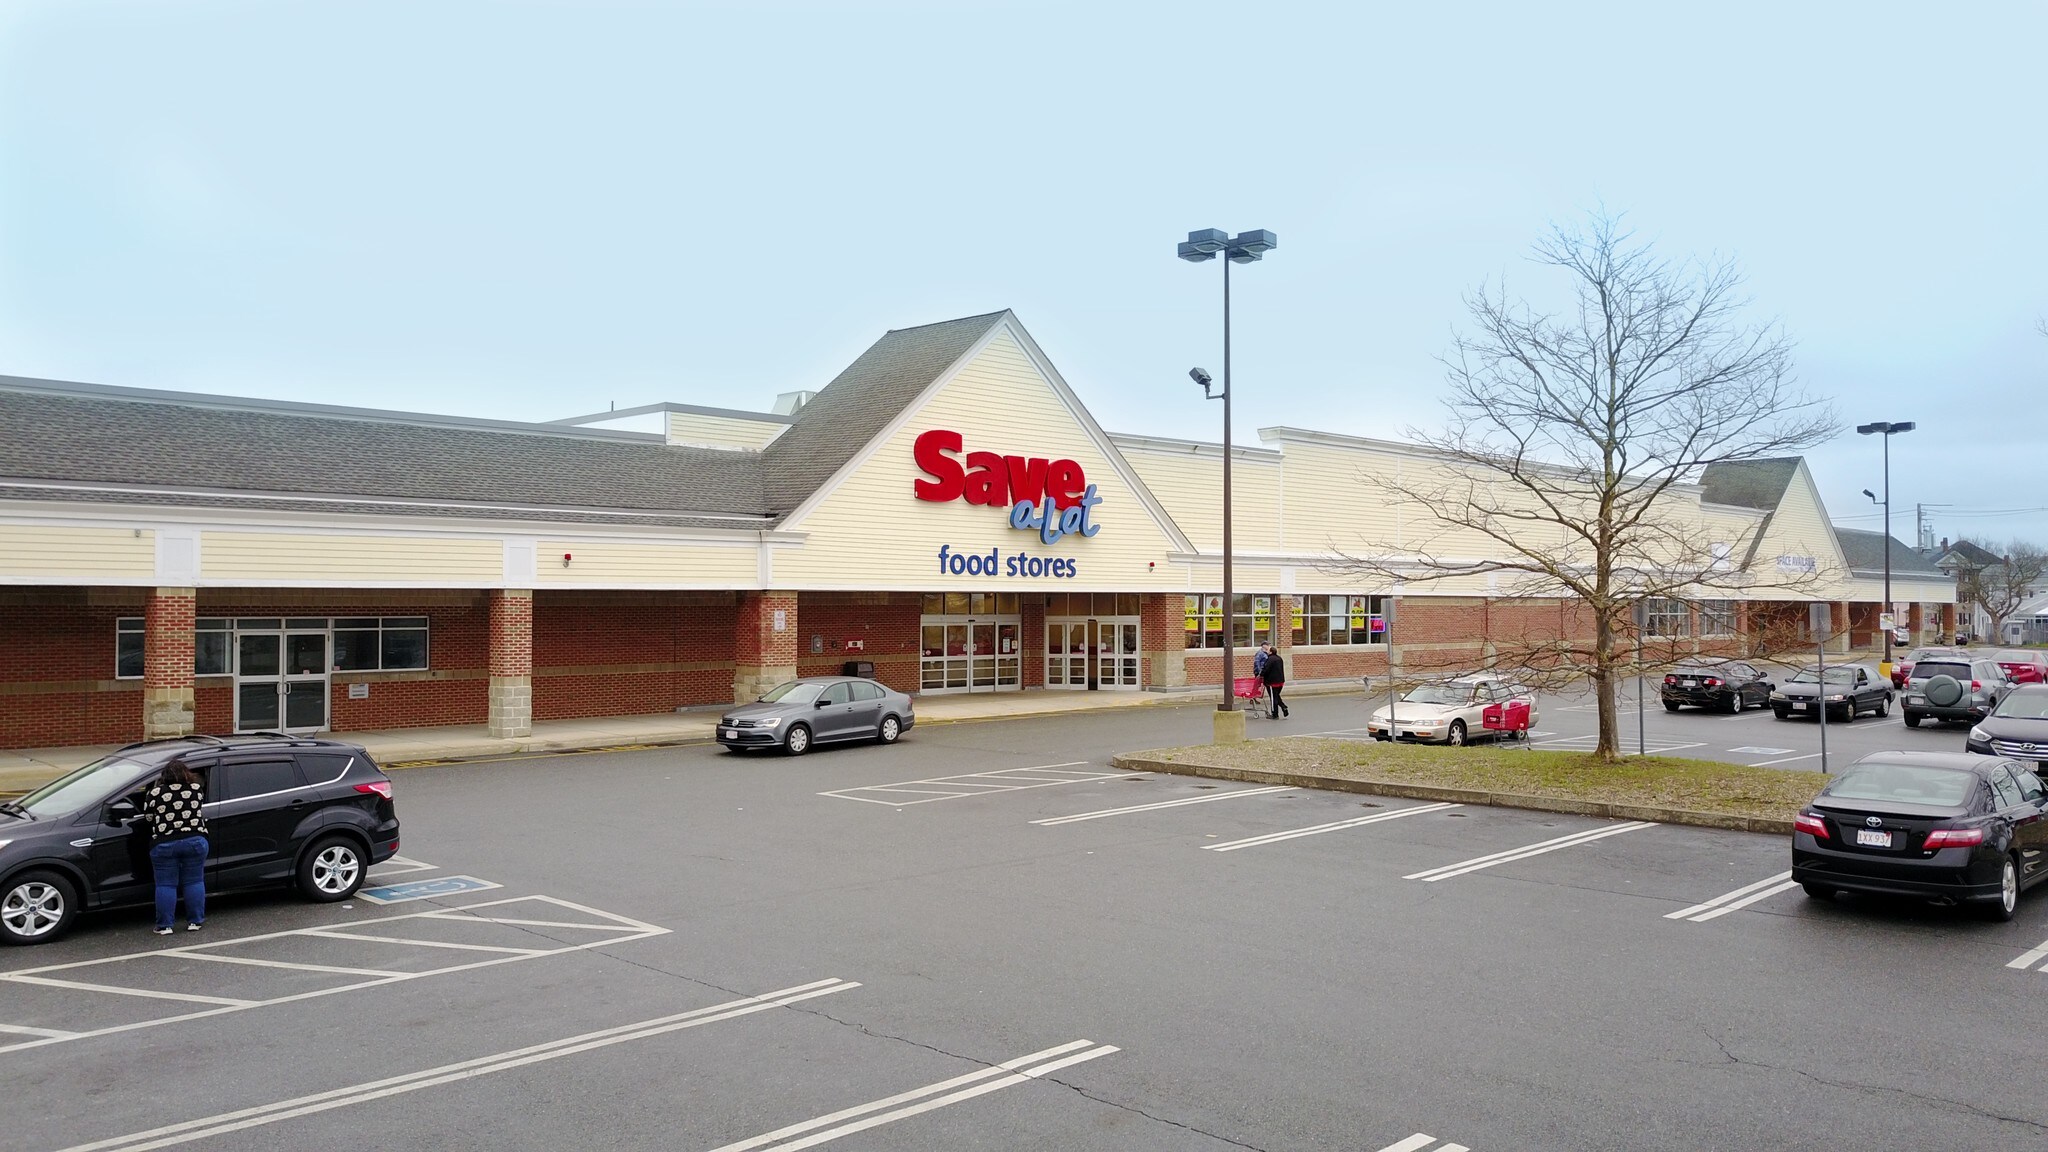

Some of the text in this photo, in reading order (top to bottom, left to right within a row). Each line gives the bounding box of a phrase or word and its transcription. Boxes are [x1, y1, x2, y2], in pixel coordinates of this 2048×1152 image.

[914, 430, 1086, 511] Save
[938, 544, 1077, 578] food stores
[1776, 555, 1791, 566] SPACE
[1858, 833, 1873, 843] 1XX
